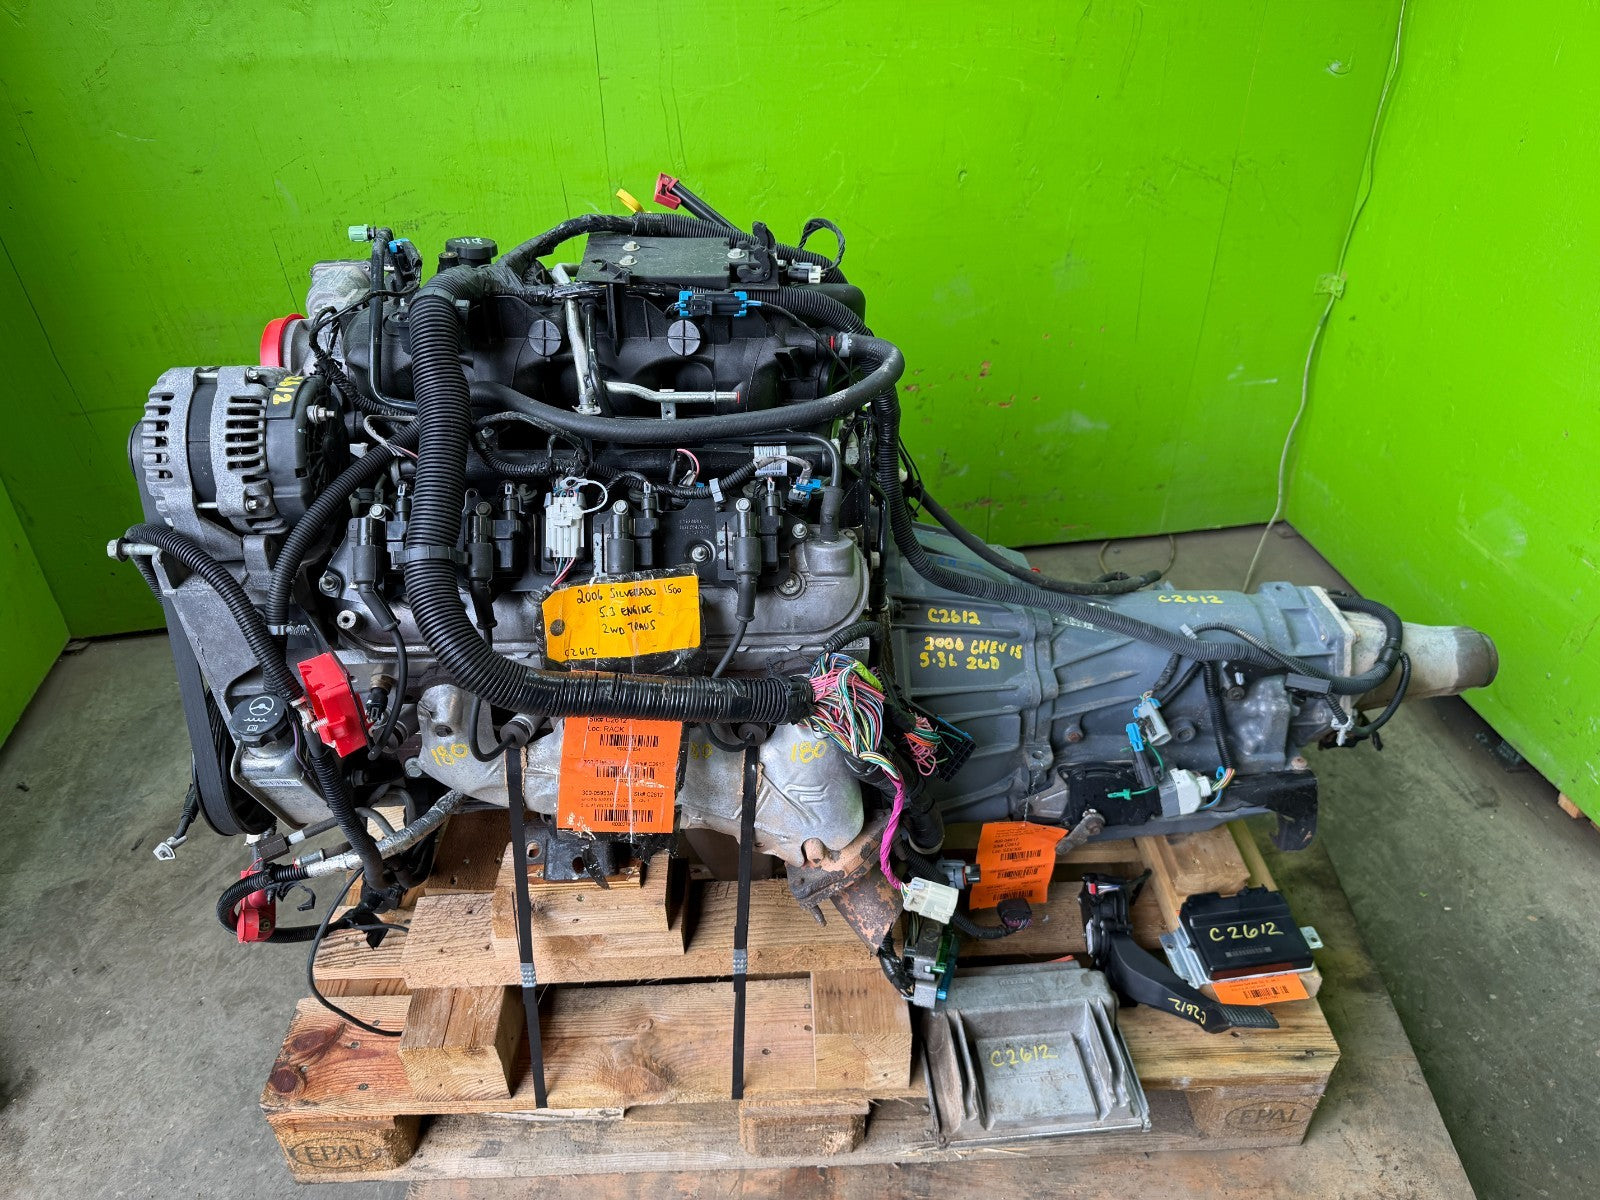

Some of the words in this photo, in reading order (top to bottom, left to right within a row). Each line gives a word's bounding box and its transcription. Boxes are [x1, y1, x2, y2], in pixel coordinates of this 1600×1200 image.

[577, 588, 604, 604] 2006
[664, 583, 683, 594] 1500
[1158, 594, 1224, 604] C2612
[599, 606, 616, 618] 5.3
[621, 604, 653, 617] ENGINE
[927, 607, 981, 626] C2612
[603, 624, 625, 636] 2WD
[628, 619, 656, 634] TRANS
[564, 647, 598, 657] C2612
[970, 639, 1007, 655] CHEV
[603, 725, 625, 733] RACK
[431, 743, 469, 767] 180
[791, 740, 828, 765] 180
[1209, 921, 1284, 942] C2612
[1168, 997, 1207, 1025] C2612
[990, 1044, 1059, 1067] C2612
[1240, 1108, 1304, 1124] EPAL
[304, 1145, 367, 1162] EPAL
